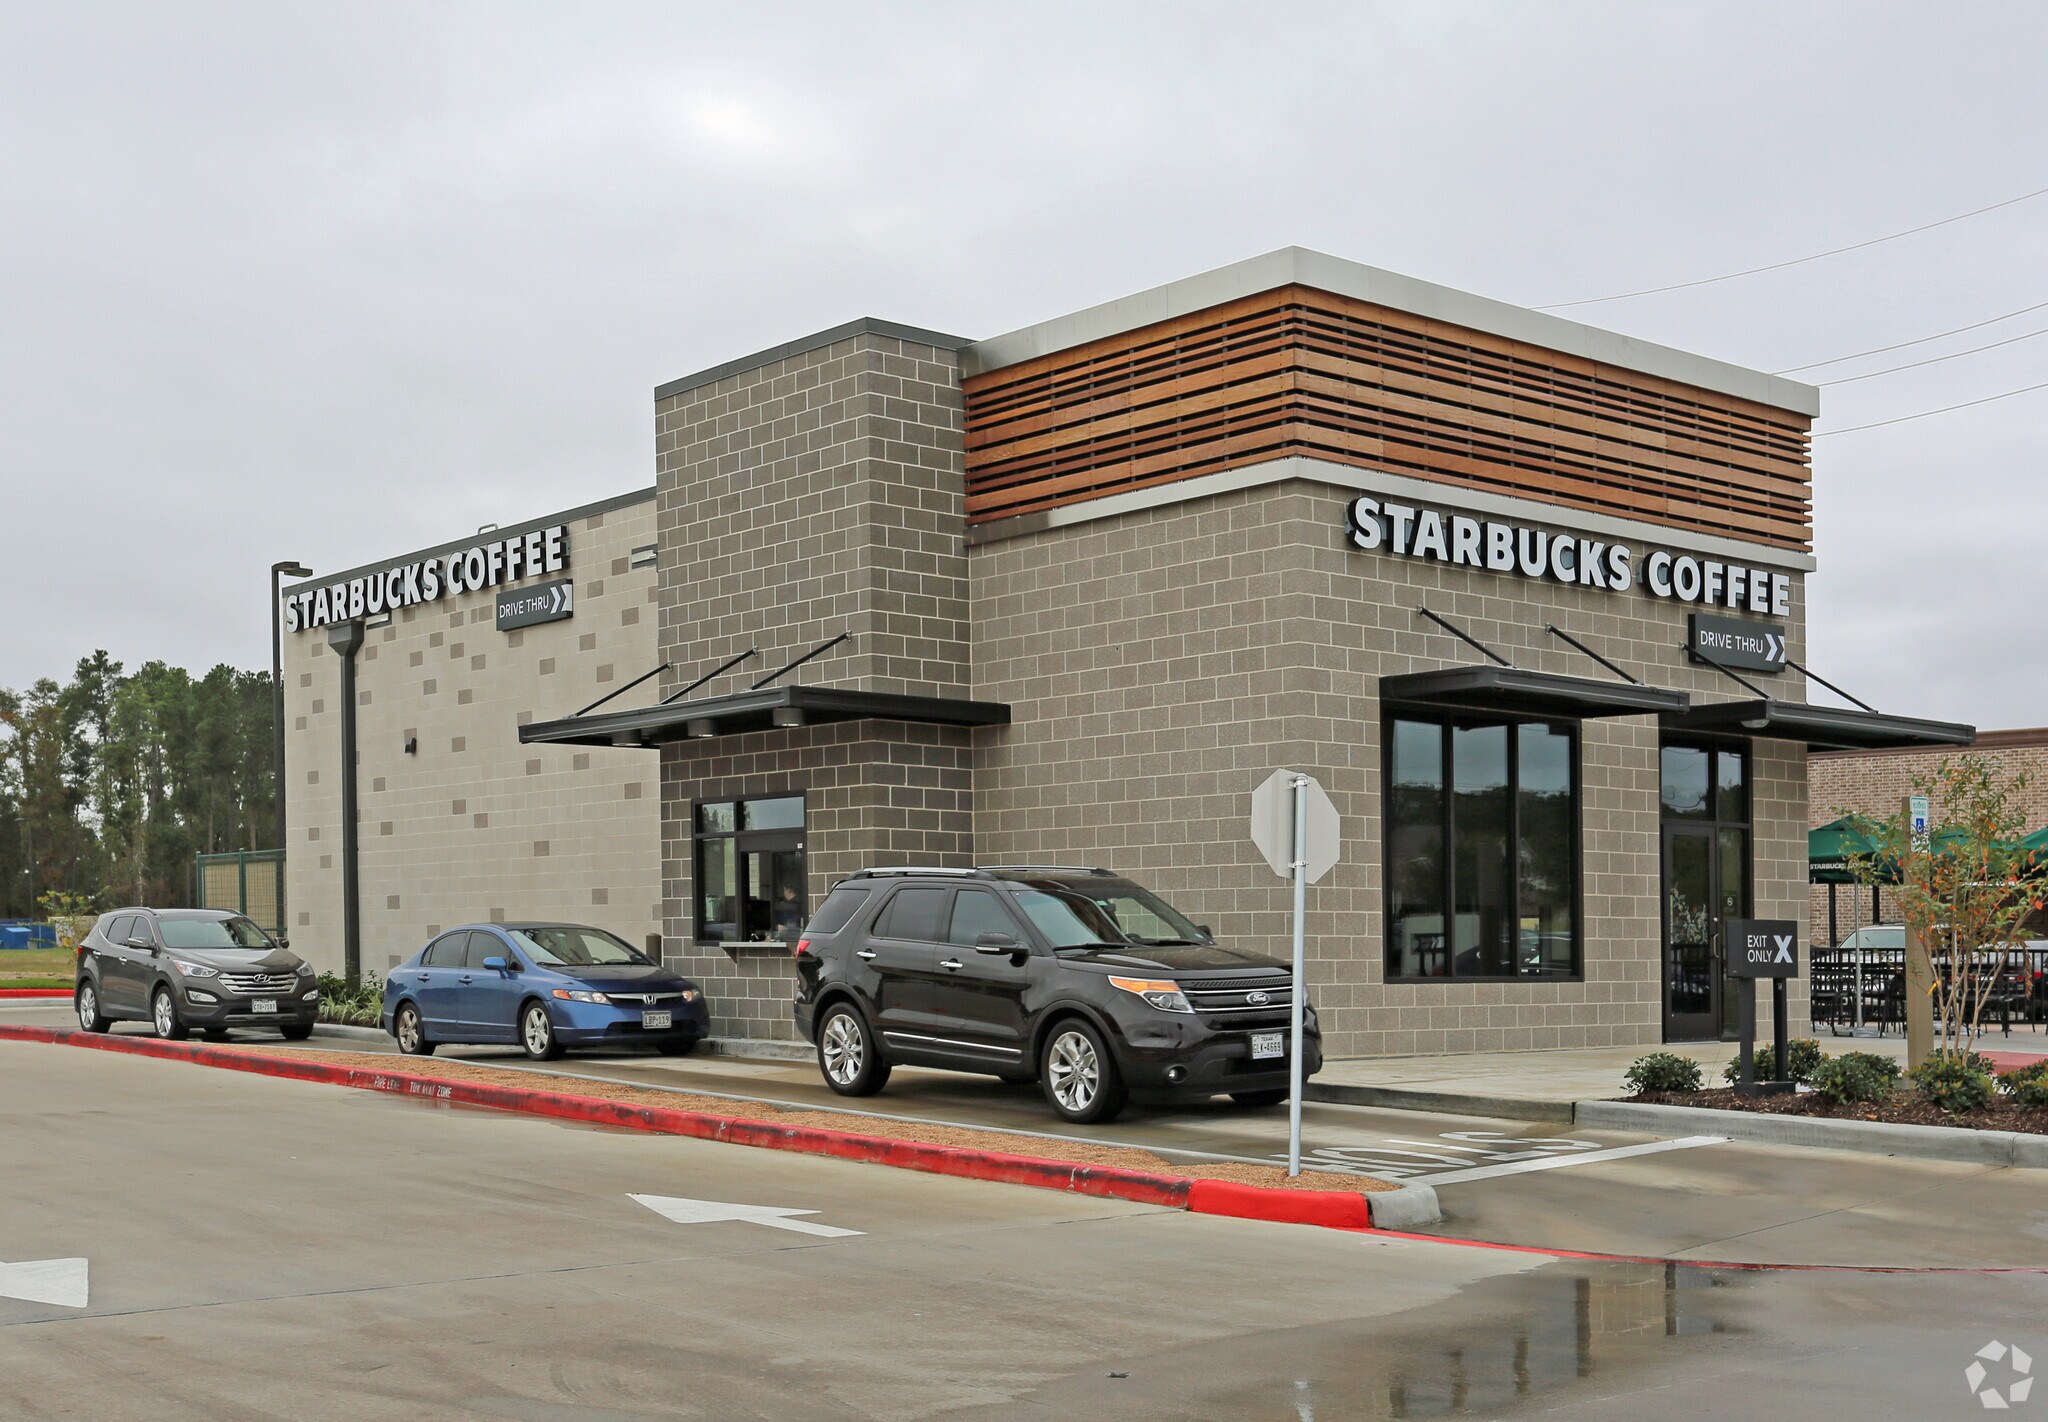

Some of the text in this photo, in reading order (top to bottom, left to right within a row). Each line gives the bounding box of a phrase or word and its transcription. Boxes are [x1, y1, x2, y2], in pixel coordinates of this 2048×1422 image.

[1353, 496, 1791, 617] STARBUCKS COFFEE
[286, 525, 564, 633] STARBUCKS COFFEE
[500, 595, 549, 618] DRIVE THRU
[1700, 630, 1763, 653] DRIVE THRU
[1747, 935, 1767, 947] EXIT
[1747, 949, 1772, 962] ONLY
